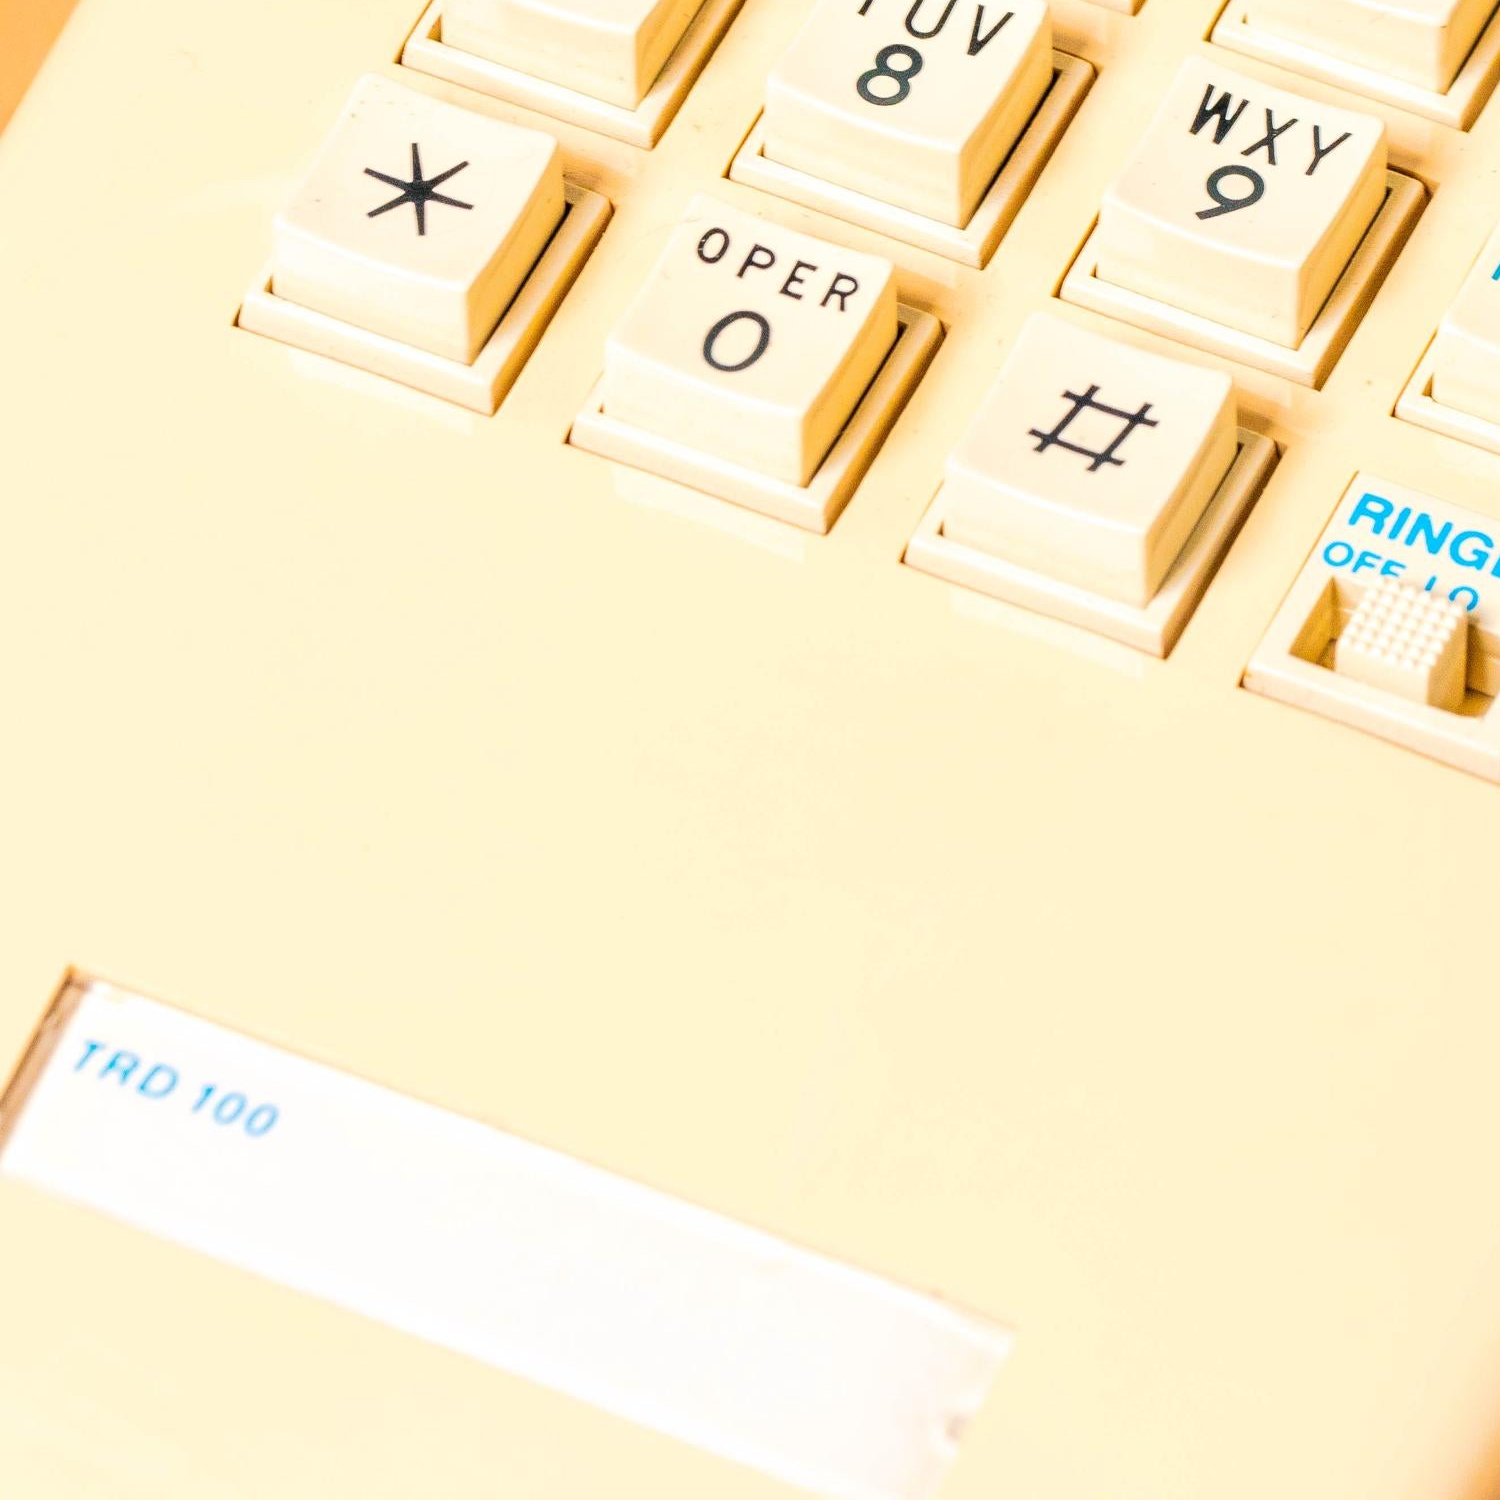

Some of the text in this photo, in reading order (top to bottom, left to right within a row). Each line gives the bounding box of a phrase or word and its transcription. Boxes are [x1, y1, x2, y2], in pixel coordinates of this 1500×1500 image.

[856, 43, 923, 107] 8
[1189, 83, 1353, 178] WXY
[1195, 163, 1264, 223] 9
[696, 225, 861, 315] OPER
[1027, 384, 1159, 471] #
[72, 1039, 280, 1138] TRD 100
